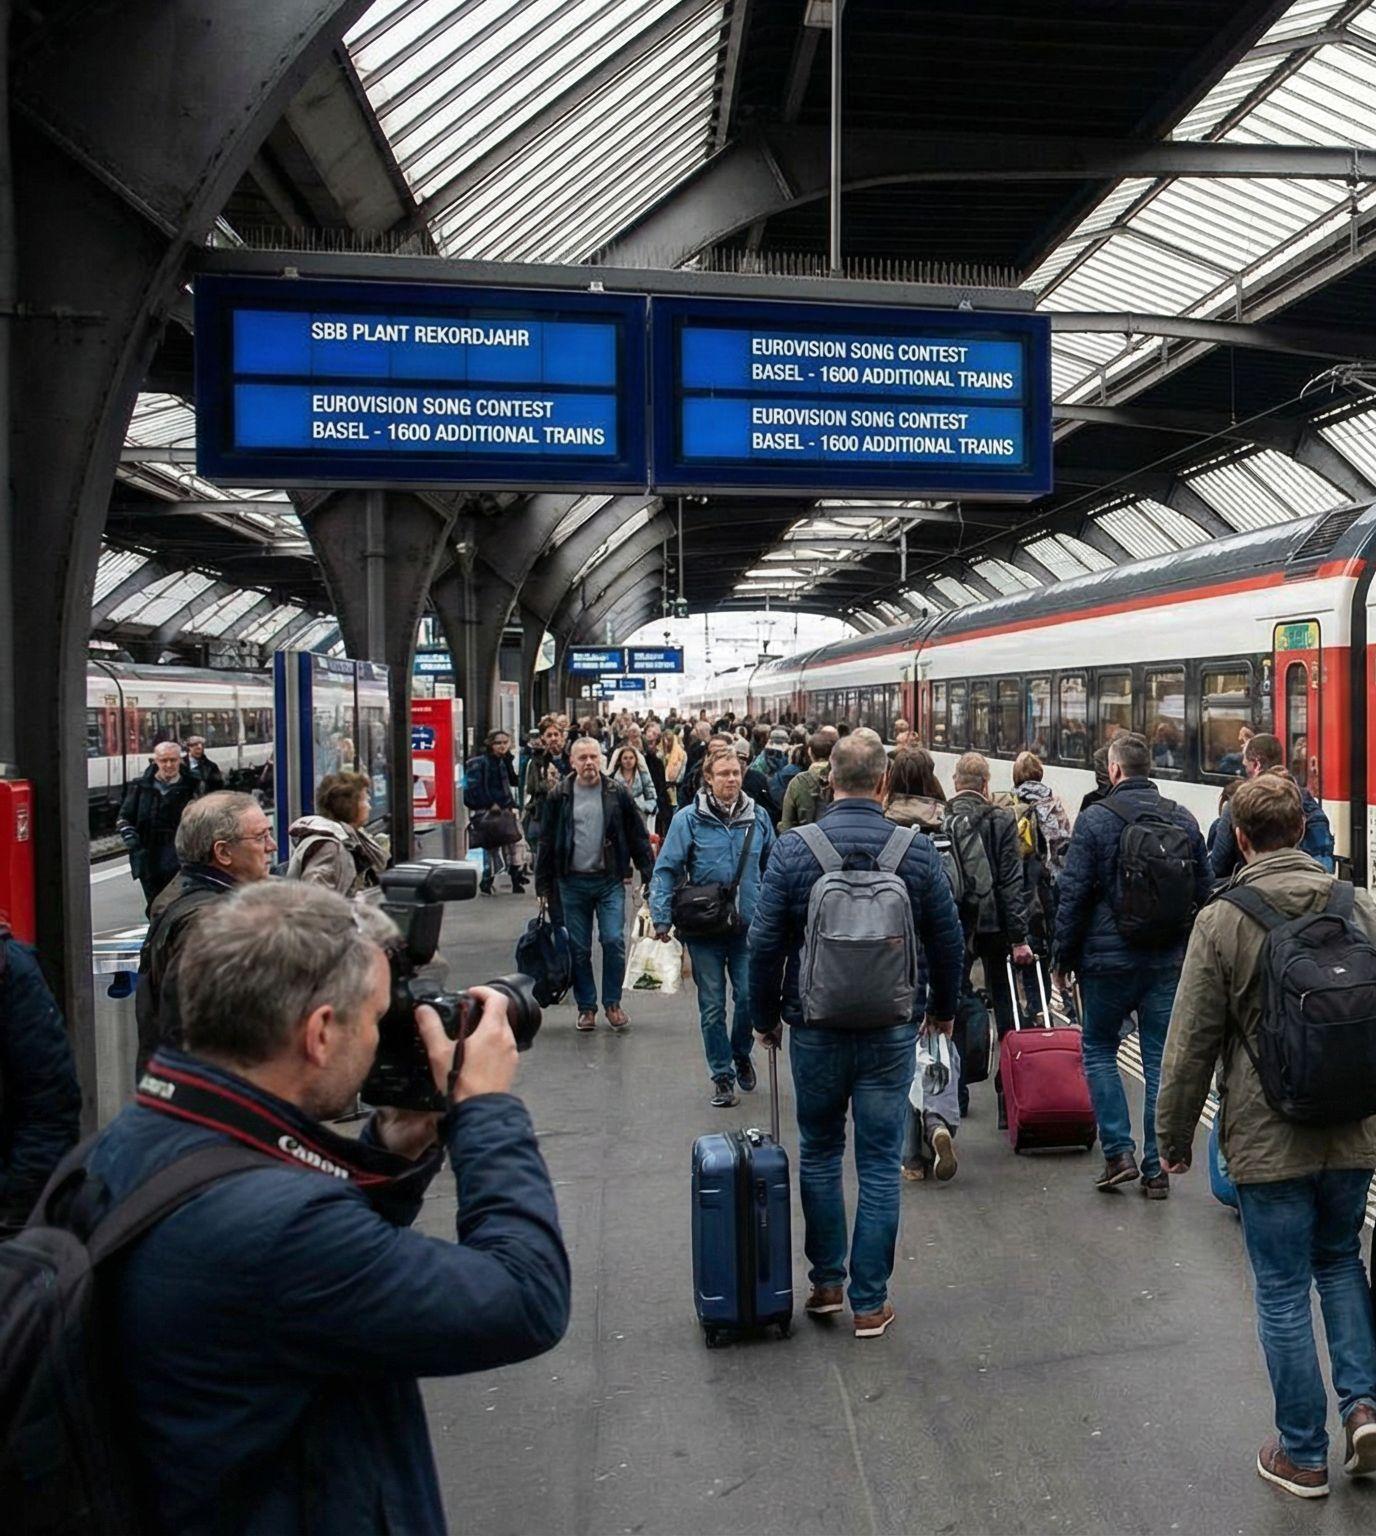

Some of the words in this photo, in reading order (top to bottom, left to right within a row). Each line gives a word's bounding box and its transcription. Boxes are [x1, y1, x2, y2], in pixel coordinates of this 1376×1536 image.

[312, 322, 347, 340] SBB
[353, 324, 409, 342] PLANT
[415, 326, 529, 346] REKORDJAHR
[753, 339, 846, 358] EUROVISION
[851, 343, 894, 360] SONG
[899, 345, 968, 363] CONTEST
[753, 364, 803, 381] BASEL
[820, 366, 858, 383] 1600
[862, 368, 954, 387] ADDITIONAL
[958, 371, 1013, 389] TRAINS
[313, 395, 417, 414] EUROVISION
[423, 397, 471, 416] SONG
[476, 399, 553, 418] CONTEST
[753, 408, 846, 426] EUROVISION
[851, 410, 894, 428] SONG
[899, 412, 968, 430] CONTEST
[313, 422, 369, 440] BASEL
[387, 423, 430, 441] 1600
[435, 424, 538, 443] ADDITIONAL
[544, 427, 605, 445] TRAINS
[753, 433, 804, 450] BASEL
[820, 435, 858, 452] 1600
[862, 436, 955, 454] ADDITIONAL
[958, 439, 1014, 455] TRAINS
[278, 1135, 349, 1179] Canon
